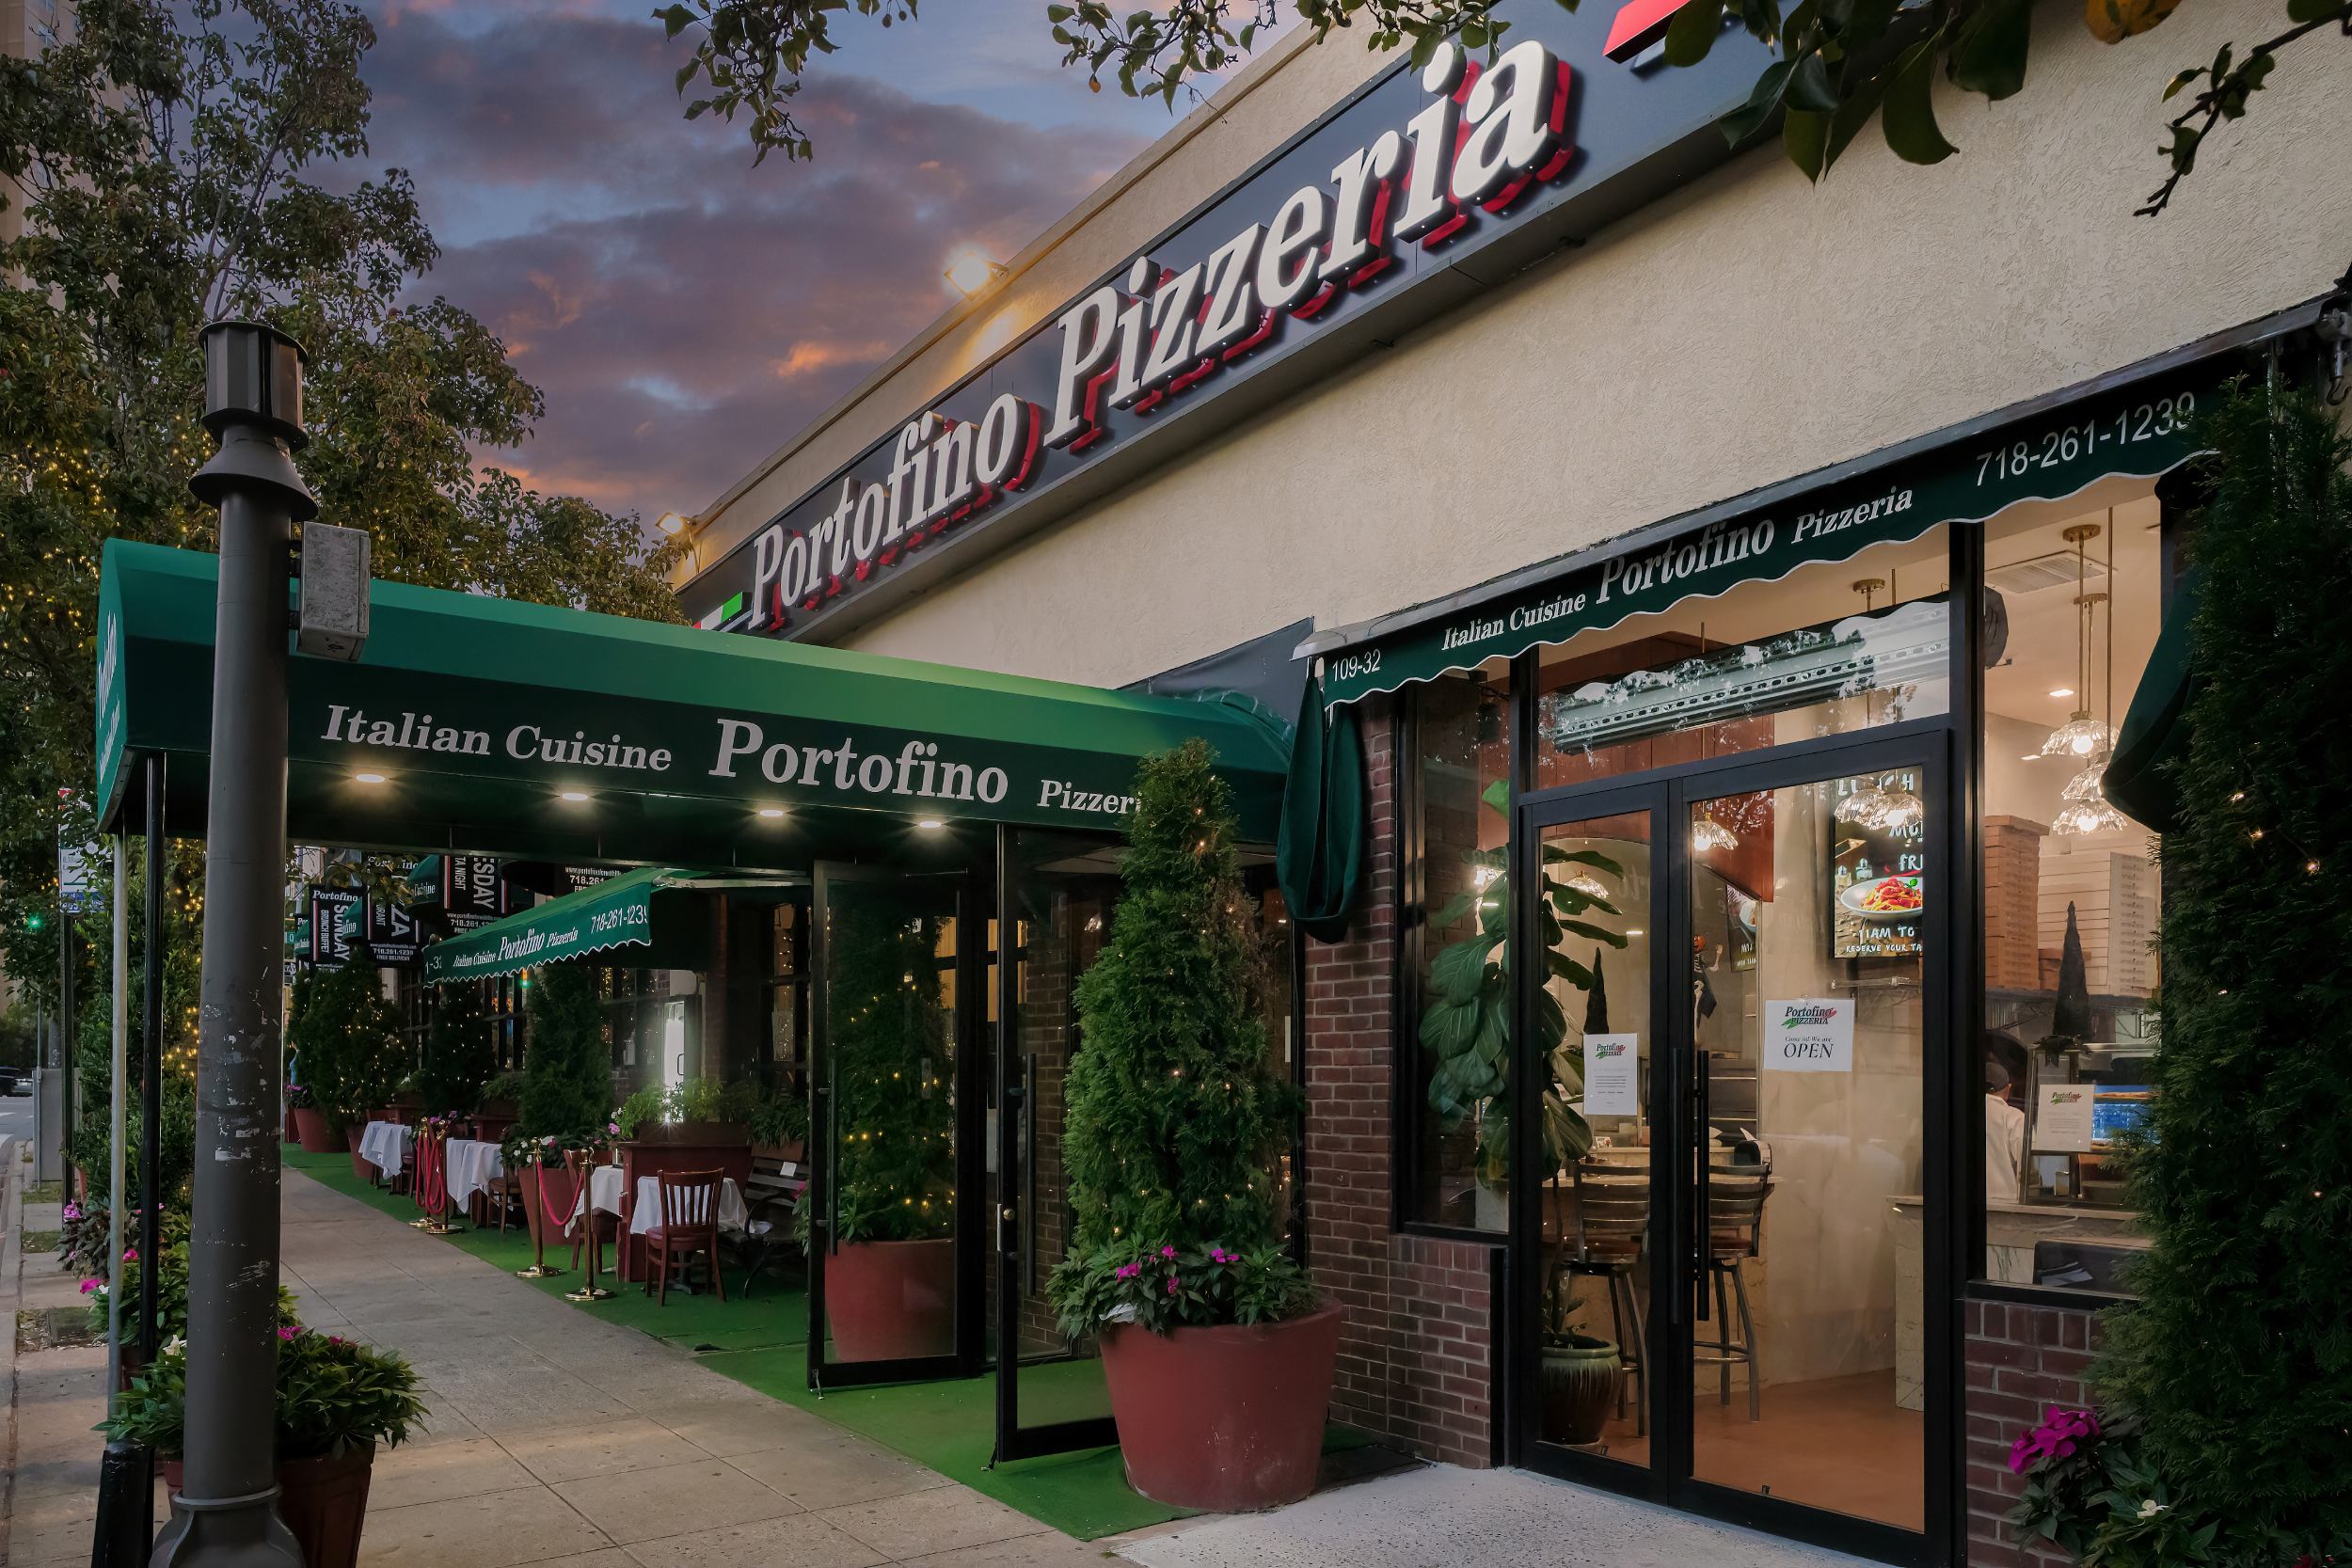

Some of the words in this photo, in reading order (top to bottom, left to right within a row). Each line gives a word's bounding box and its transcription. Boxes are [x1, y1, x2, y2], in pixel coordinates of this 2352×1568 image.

[748, 393, 1022, 630] Portofino
[1044, 40, 1560, 449] Pizzeria
[1332, 648, 1382, 682] 109-32
[1440, 616, 1504, 651] Italian
[1509, 594, 1586, 631] Cuisine
[1596, 519, 1775, 604] Portofino
[1790, 485, 1913, 545] Pizzeria
[1976, 391, 2196, 486] 718-261-1239
[320, 705, 491, 755] Italian
[505, 725, 672, 771] Cuisine
[707, 718, 1009, 803] Portofino
[454, 867, 466, 891] NIGHT
[311, 889, 359, 903] Portofino
[1898, 926, 1915, 938] TO
[497, 927, 547, 961] Portofino
[546, 927, 579, 948] Pizzeria
[1846, 944, 1882, 953] RESERVE
[1785, 1006, 1834, 1018] Portofino
[1790, 1017, 1829, 1025] PIZZERIA
[1783, 1042, 1835, 1059] OPEN
